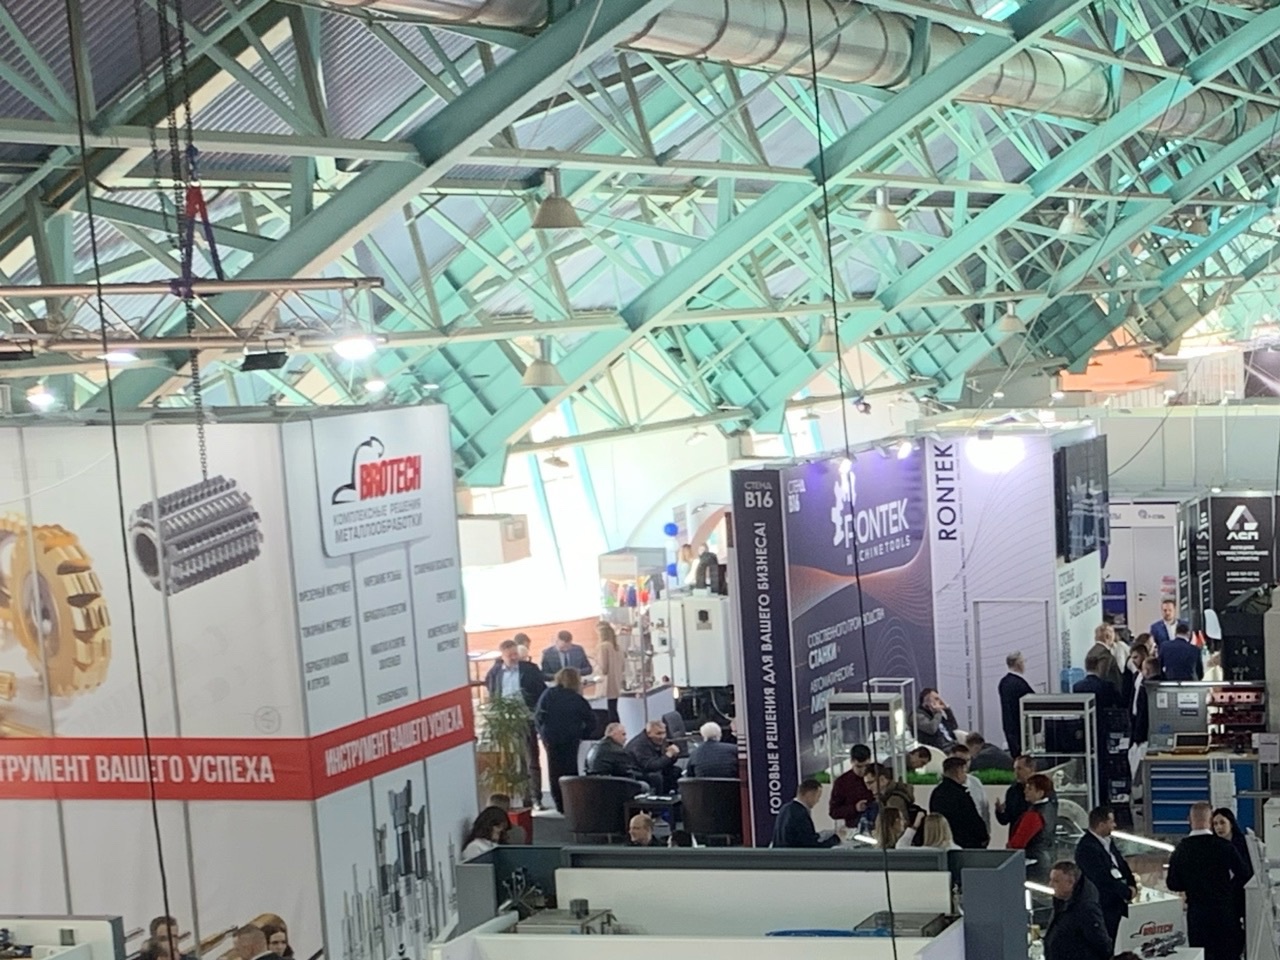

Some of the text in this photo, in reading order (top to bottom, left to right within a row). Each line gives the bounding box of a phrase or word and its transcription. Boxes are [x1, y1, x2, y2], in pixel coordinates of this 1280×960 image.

[360, 455, 422, 501] BROTECH
[934, 444, 957, 541] RONTEK
[753, 522, 782, 815] ГОТОВЫЕ РЕШЕНИЯ ДЛЯ ВАШЕГО БИЗНЕСА!
[95, 755, 183, 783] ВАШЕГО
[190, 755, 275, 783] УСПЕХА
[324, 704, 465, 778] ИНСТРУМЕНТ ВАШЕГО УСПЕХА
